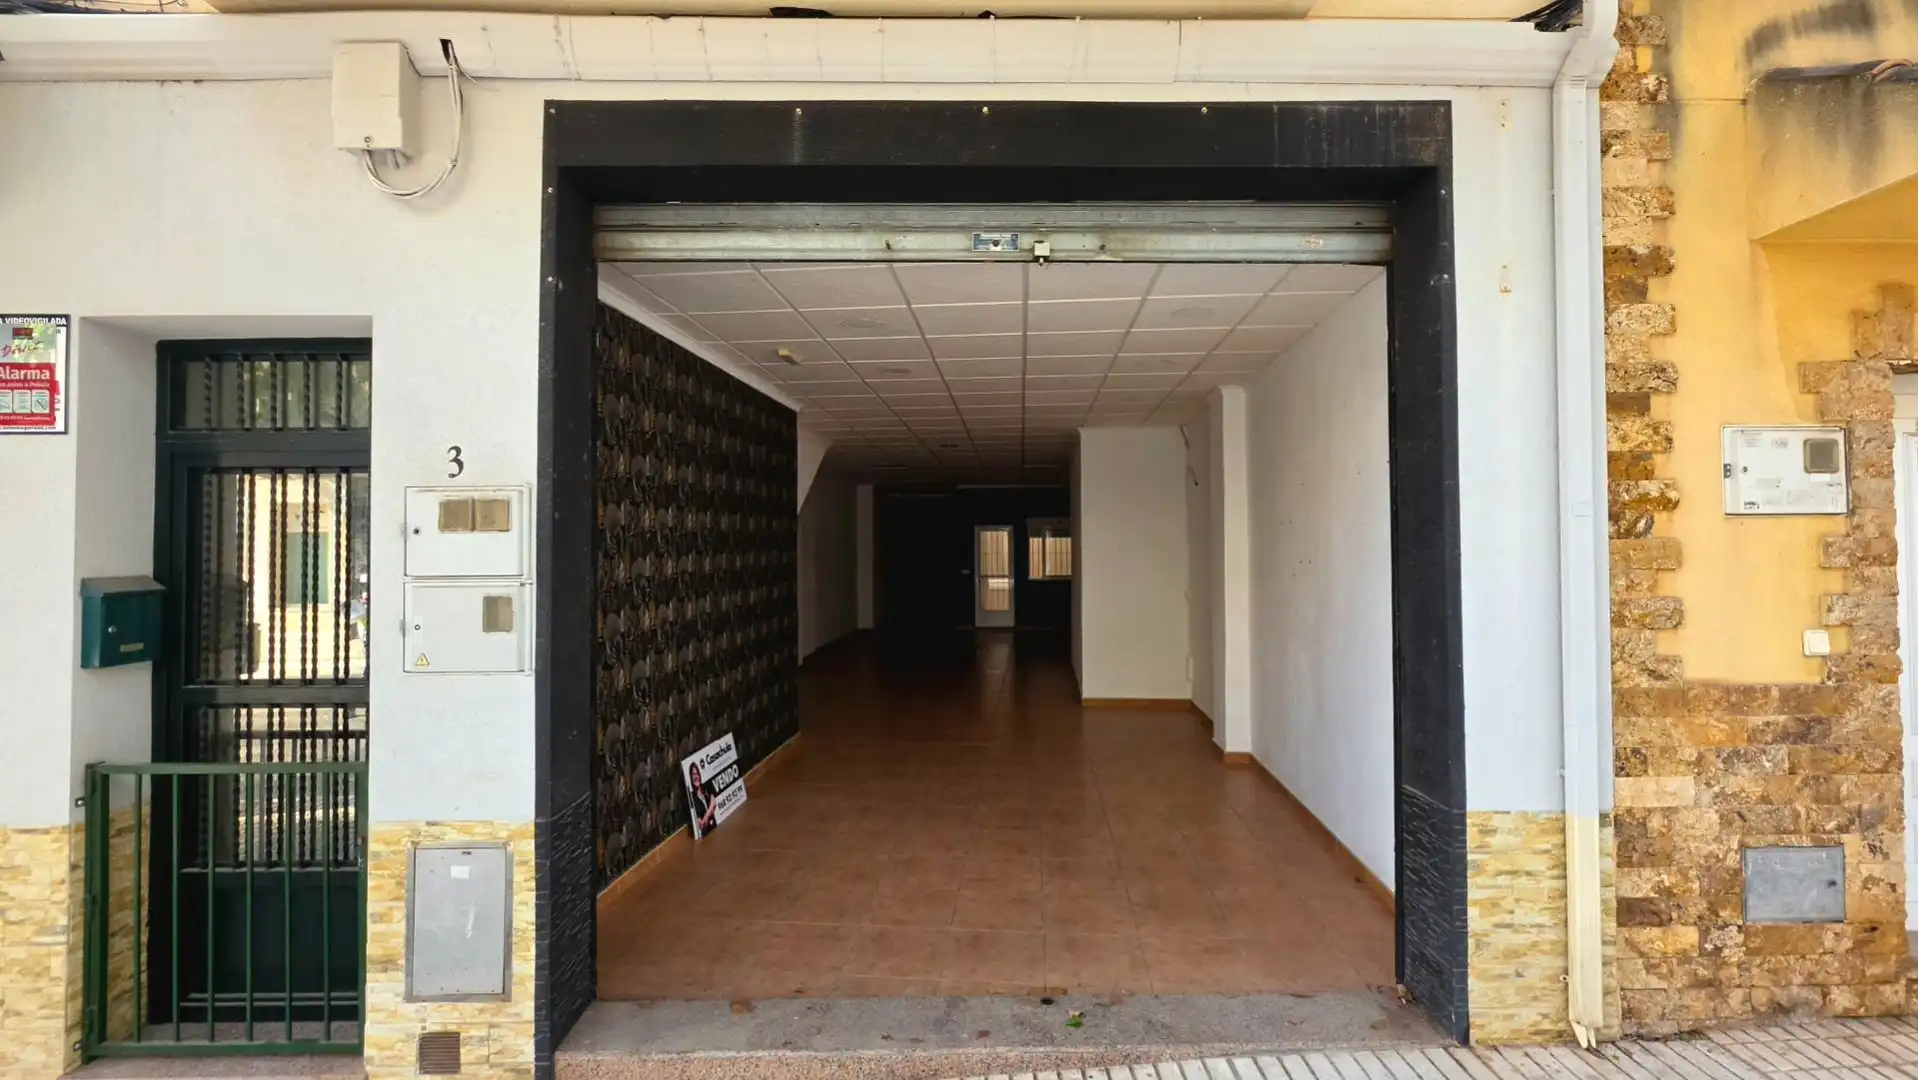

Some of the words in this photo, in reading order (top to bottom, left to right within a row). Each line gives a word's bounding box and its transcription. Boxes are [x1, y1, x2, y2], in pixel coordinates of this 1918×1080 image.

[5, 317, 67, 325] VIDEOVIGILADA
[0, 366, 50, 380] Alarma
[446, 445, 465, 479] 3
[711, 763, 740, 793] VENDO
